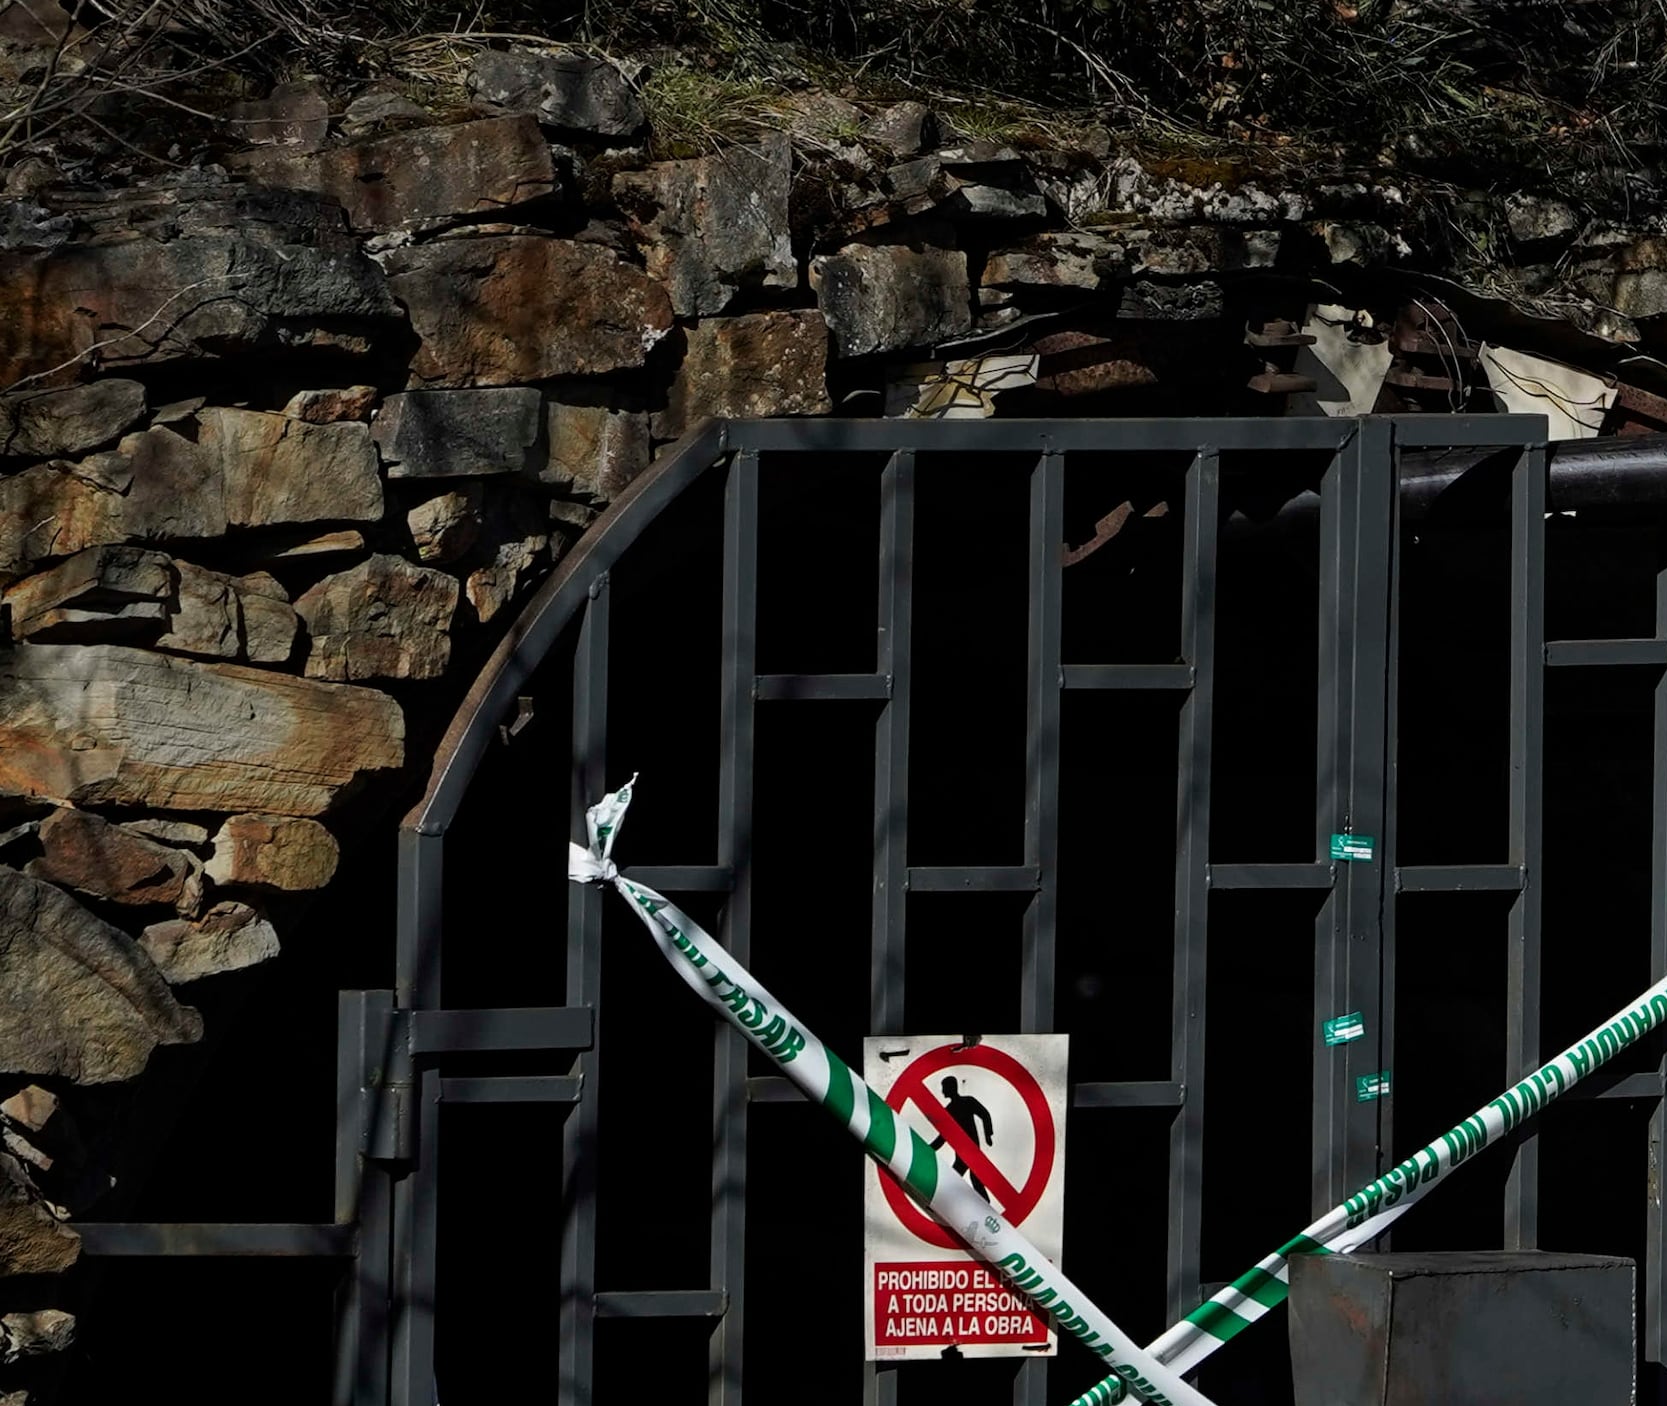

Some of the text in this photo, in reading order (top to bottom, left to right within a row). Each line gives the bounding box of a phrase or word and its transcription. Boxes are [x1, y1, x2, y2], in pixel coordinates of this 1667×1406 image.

[1441, 1114, 1488, 1167] NO
[878, 1269, 969, 1291] PROHIBIDO
[973, 1269, 995, 1289] EL
[887, 1294, 900, 1314] A
[902, 1293, 949, 1314] TODA
[885, 1315, 1034, 1337] AJENA A LA OBRA
